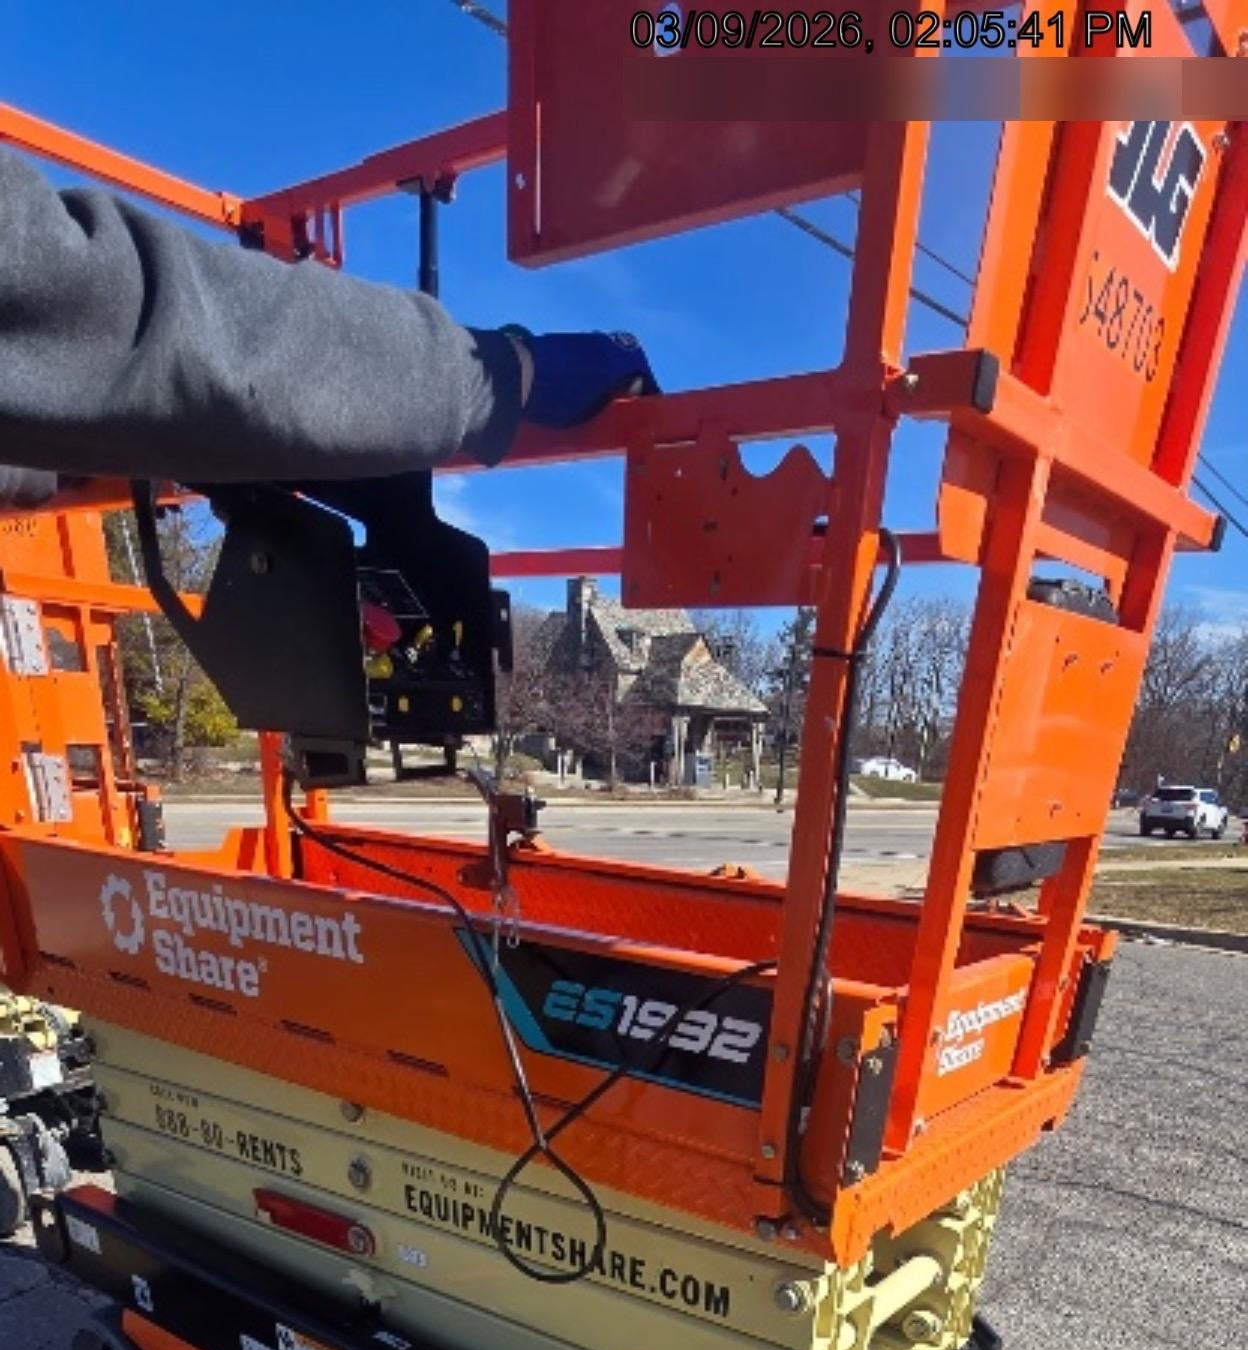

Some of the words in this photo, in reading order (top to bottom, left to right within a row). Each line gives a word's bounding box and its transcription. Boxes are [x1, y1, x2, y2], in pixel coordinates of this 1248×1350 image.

[143, 869, 364, 964] Equipment
[542, 979, 763, 1064] ES1932
[944, 987, 1027, 1042] Equipment
[403, 1183, 732, 1318] EQUIPMENTSHARE.COM
